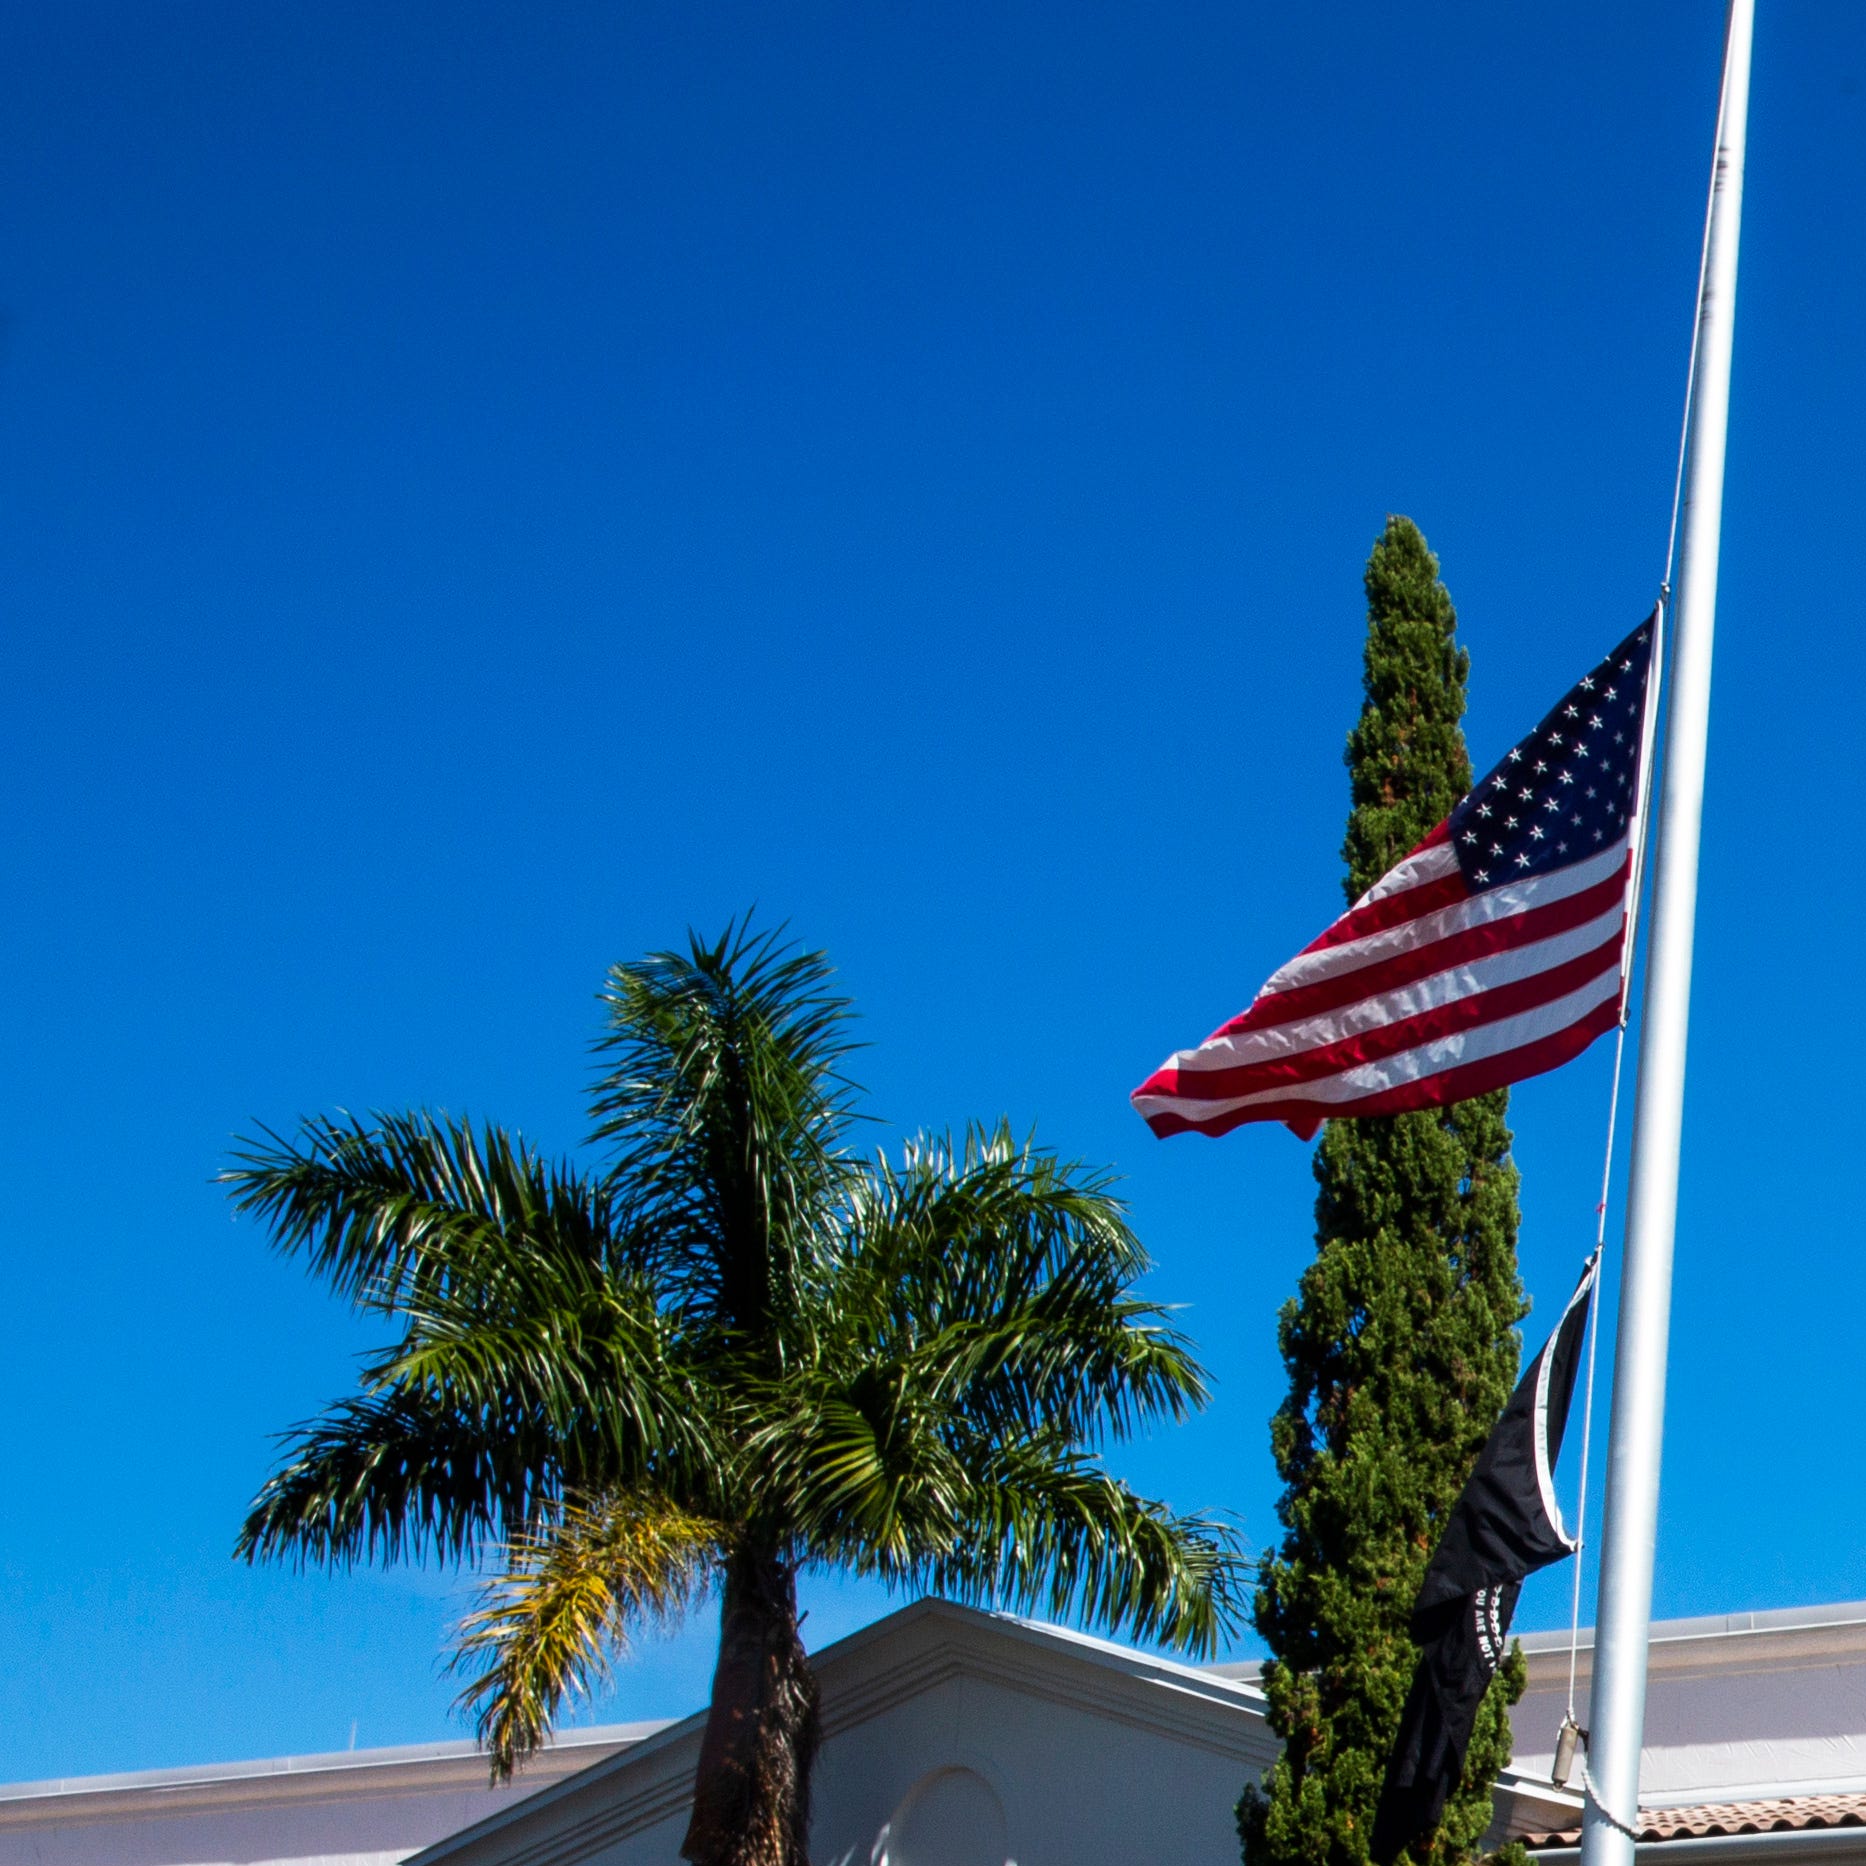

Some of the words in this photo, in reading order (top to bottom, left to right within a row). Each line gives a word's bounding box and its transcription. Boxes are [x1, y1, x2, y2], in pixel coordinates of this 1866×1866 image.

[1475, 1588, 1487, 1606] OU
[1475, 1610, 1487, 1633] ARE
[1478, 1635, 1496, 1659] NOT
